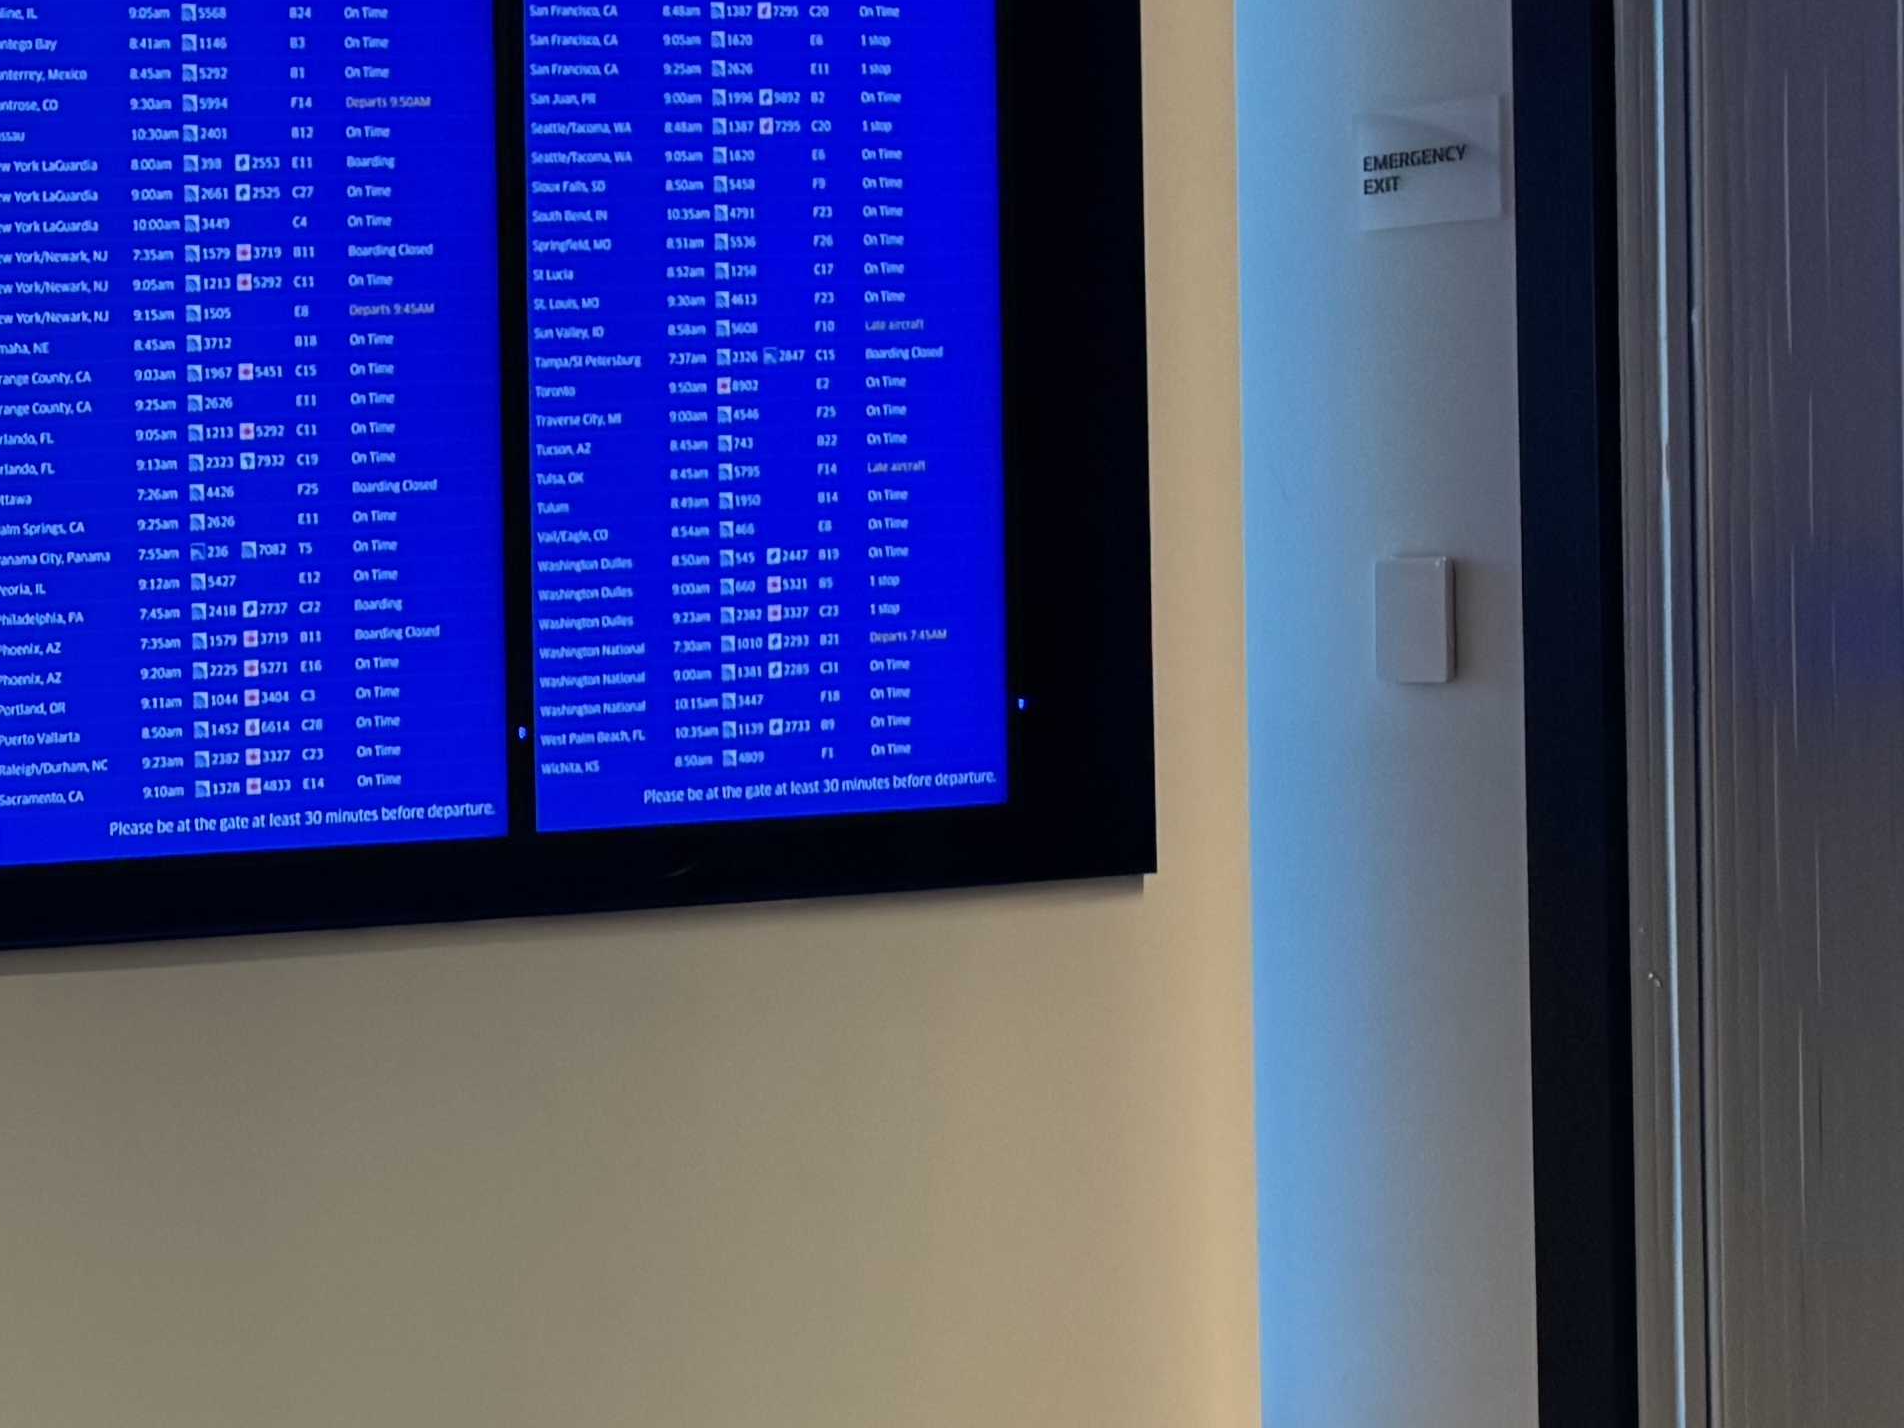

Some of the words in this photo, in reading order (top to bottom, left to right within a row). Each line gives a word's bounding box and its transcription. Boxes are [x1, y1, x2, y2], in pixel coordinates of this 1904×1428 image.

[1363, 143, 1468, 172] EMERGENCY
[1363, 175, 1401, 195] EXIT
[643, 788, 685, 804] Please
[686, 787, 704, 802] be
[705, 786, 719, 801] at
[721, 784, 743, 799] the
[744, 783, 772, 800] gate
[774, 781, 788, 796] at
[790, 779, 820, 795] least
[822, 777, 840, 793] 30
[841, 776, 890, 792] minutes
[892, 772, 933, 789] before
[933, 770, 996, 787] departure.
[108, 821, 154, 837] Please
[156, 818, 174, 834] be
[176, 817, 191, 833] at
[193, 816, 217, 832] the
[219, 815, 250, 833] gate
[251, 813, 266, 828] at
[268, 811, 301, 827] least
[304, 810, 323, 826] 30
[324, 808, 379, 824] minutes
[380, 804, 425, 821] before
[426, 802, 495, 819] departure.
